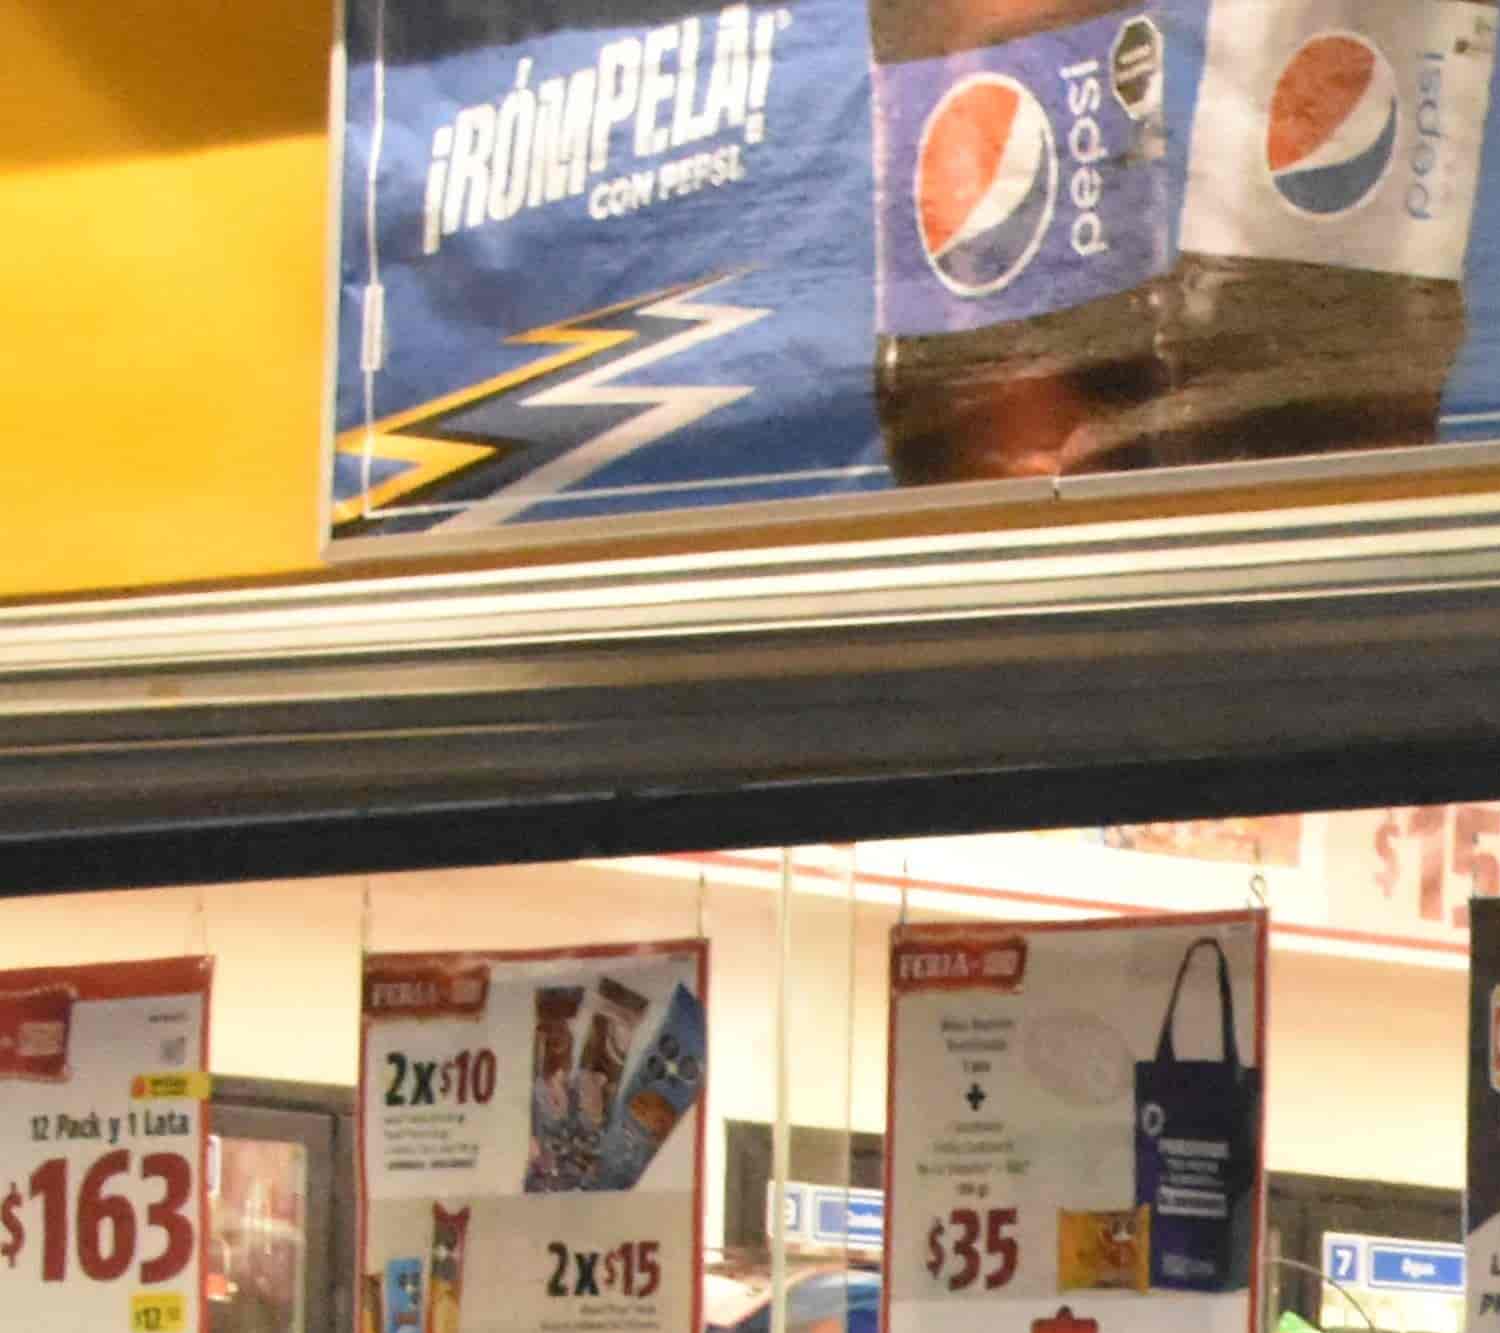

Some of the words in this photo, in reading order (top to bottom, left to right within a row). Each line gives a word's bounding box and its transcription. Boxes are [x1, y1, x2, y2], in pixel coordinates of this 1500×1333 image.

[1069, 58, 1107, 257] pepsi
[1406, 52, 1446, 220] pepsi
[1, 1149, 195, 1284] $163
[926, 1207, 1019, 1292] $35
[1334, 1250, 1353, 1277] 7
